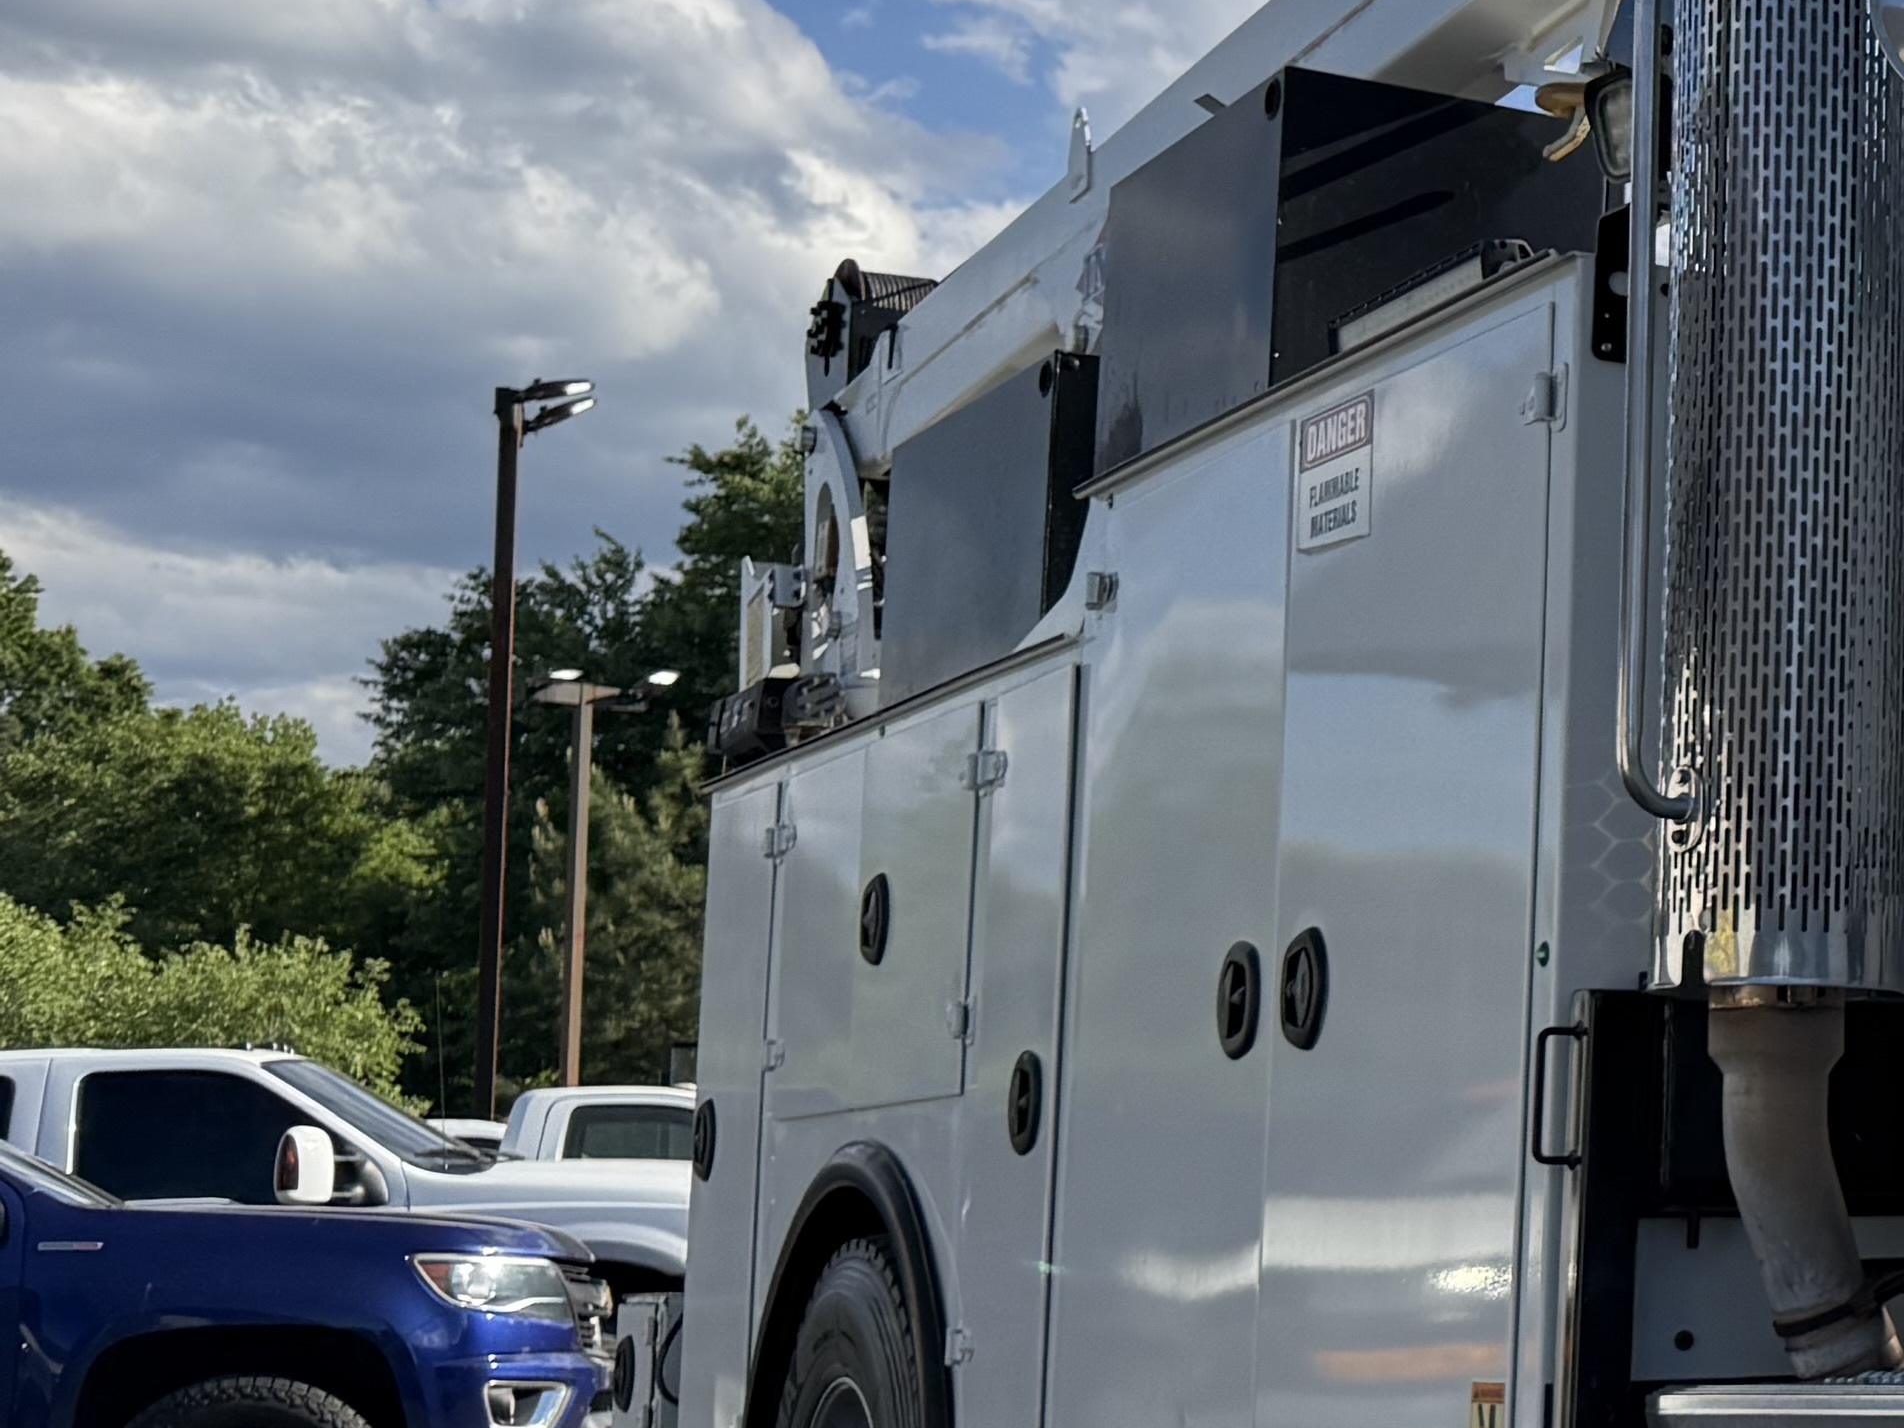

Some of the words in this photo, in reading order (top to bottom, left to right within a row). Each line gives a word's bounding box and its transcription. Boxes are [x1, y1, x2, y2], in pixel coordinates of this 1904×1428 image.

[1306, 402, 1366, 463] DANGER
[1309, 467, 1360, 509] FLAMMABLE
[1310, 500, 1358, 539] MATERIALS
